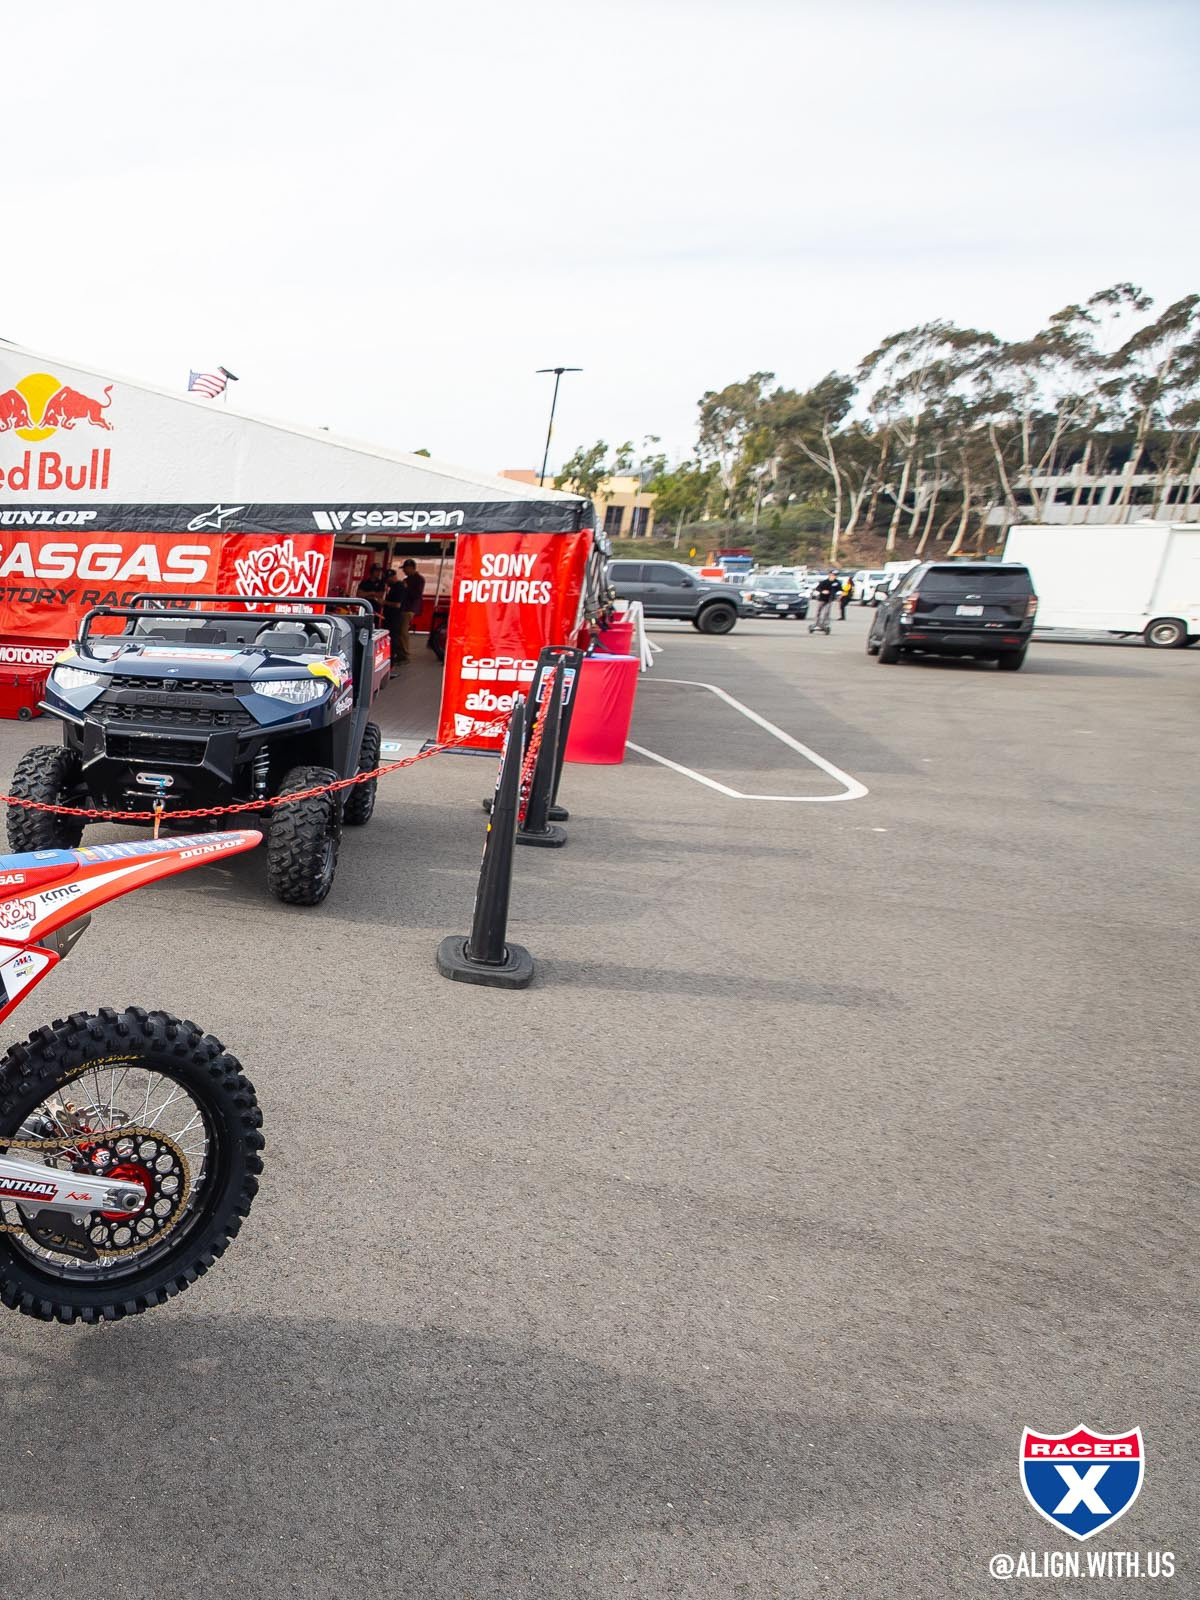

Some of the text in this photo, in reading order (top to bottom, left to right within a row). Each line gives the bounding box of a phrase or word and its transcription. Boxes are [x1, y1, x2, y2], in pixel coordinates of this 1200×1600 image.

[38, 448, 111, 490] Bull
[351, 509, 464, 531] seaspan
[234, 539, 293, 584] WOW
[479, 553, 537, 578] SONY
[458, 579, 552, 605] PICTURES
[461, 655, 538, 669] GoPro
[180, 838, 246, 860] DUNLOP
